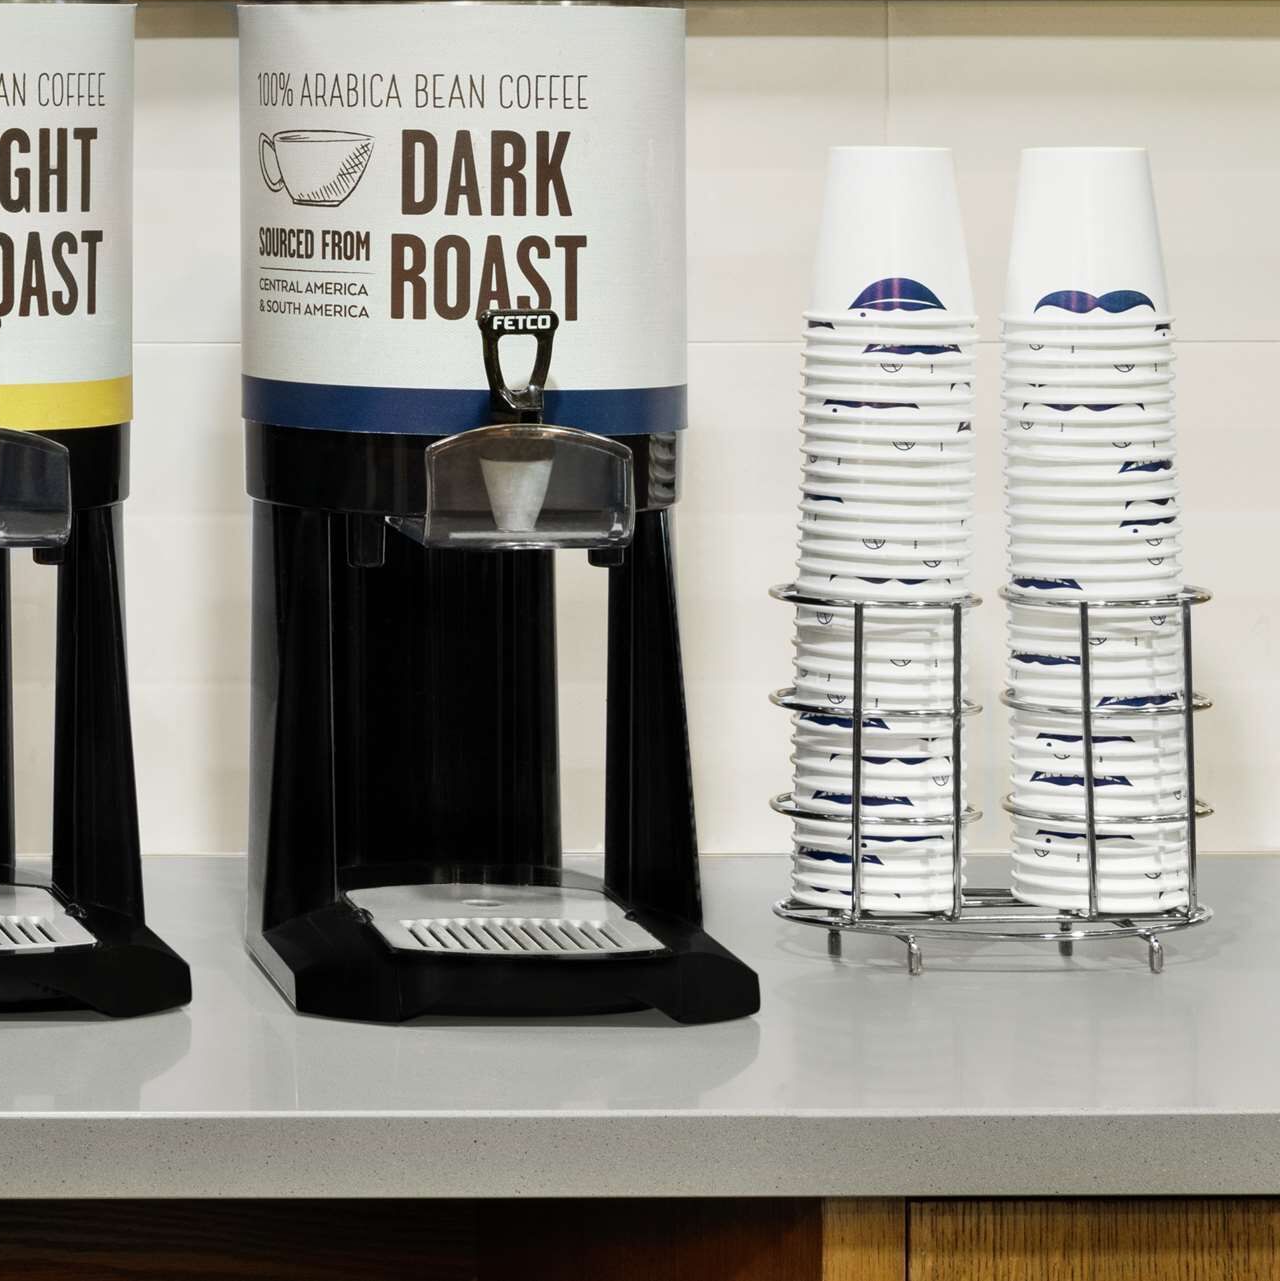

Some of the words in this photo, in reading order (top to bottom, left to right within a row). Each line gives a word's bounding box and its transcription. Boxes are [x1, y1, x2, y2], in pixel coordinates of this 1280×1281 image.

[38, 71, 106, 108] COFFEE
[257, 71, 294, 108] 100%
[300, 72, 402, 109] ARABICA
[415, 73, 486, 110] BEAN
[498, 73, 589, 110] COFFEE
[401, 129, 573, 217] DARK
[259, 226, 315, 261] SOURCED
[321, 229, 371, 262] FROM
[259, 278, 303, 294] CENTRAL
[304, 282, 369, 297] AMERICA
[390, 233, 588, 321] ROAST
[259, 299, 266, 313] &
[266, 299, 302, 315] SOUTH
[303, 303, 370, 319] AMERICA
[492, 314, 552, 330] FETCO
